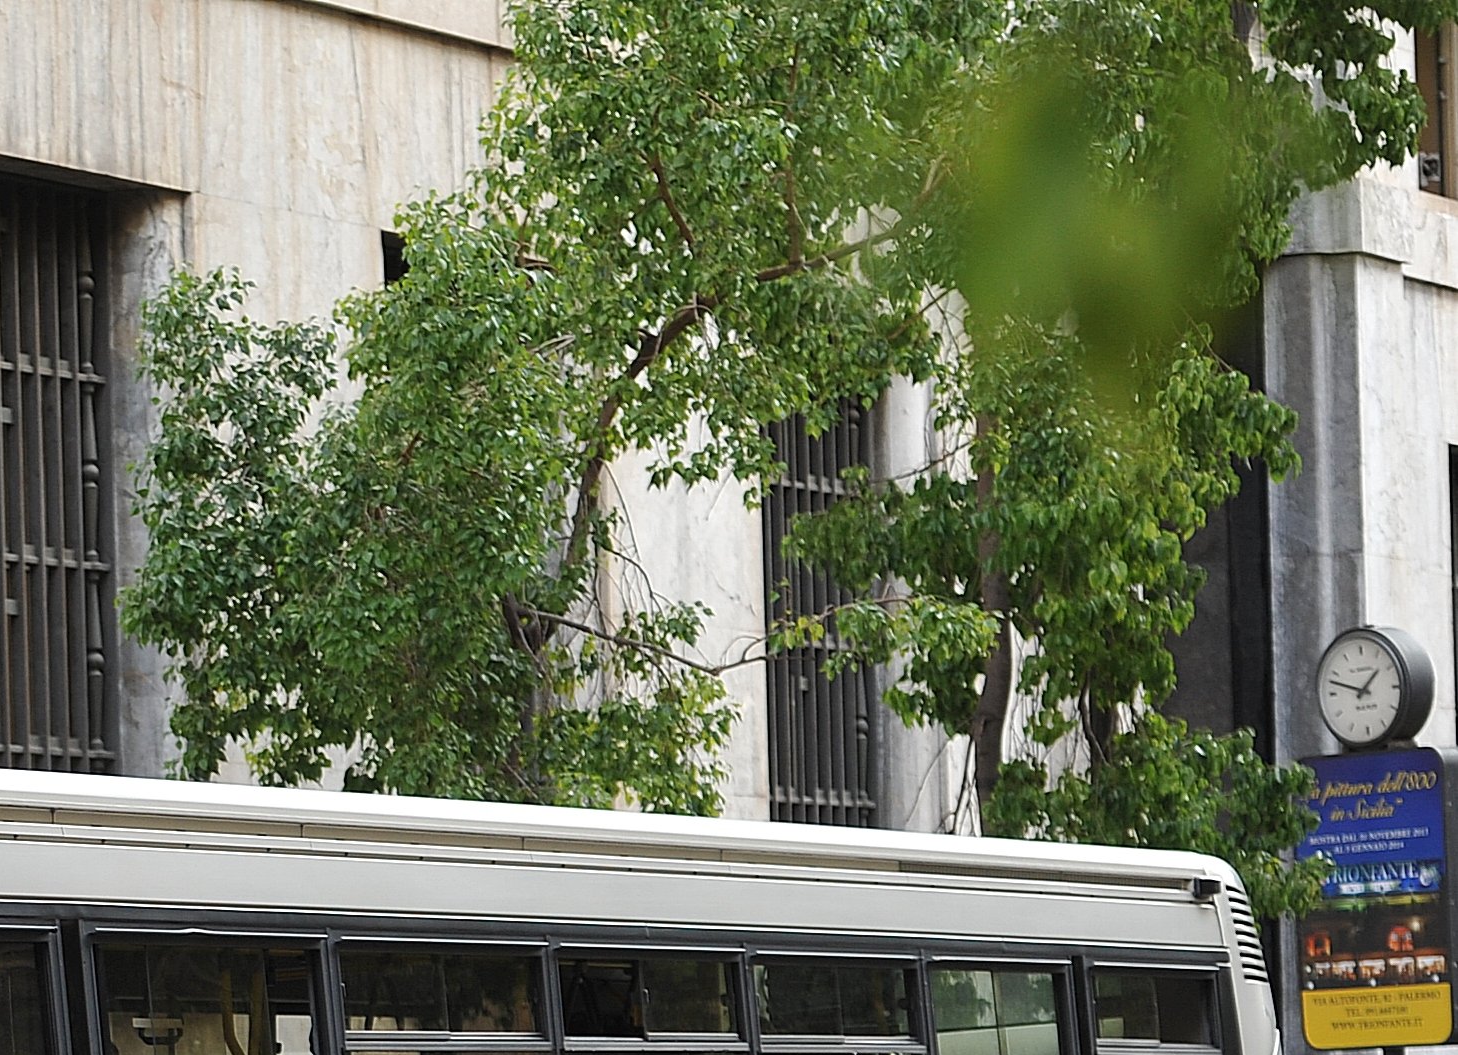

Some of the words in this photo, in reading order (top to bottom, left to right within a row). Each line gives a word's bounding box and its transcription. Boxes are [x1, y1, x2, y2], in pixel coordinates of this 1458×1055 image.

[1321, 781, 1374, 806] pittura
[1331, 805, 1345, 821] in
[1368, 829, 1411, 841] NOVEMBRE
